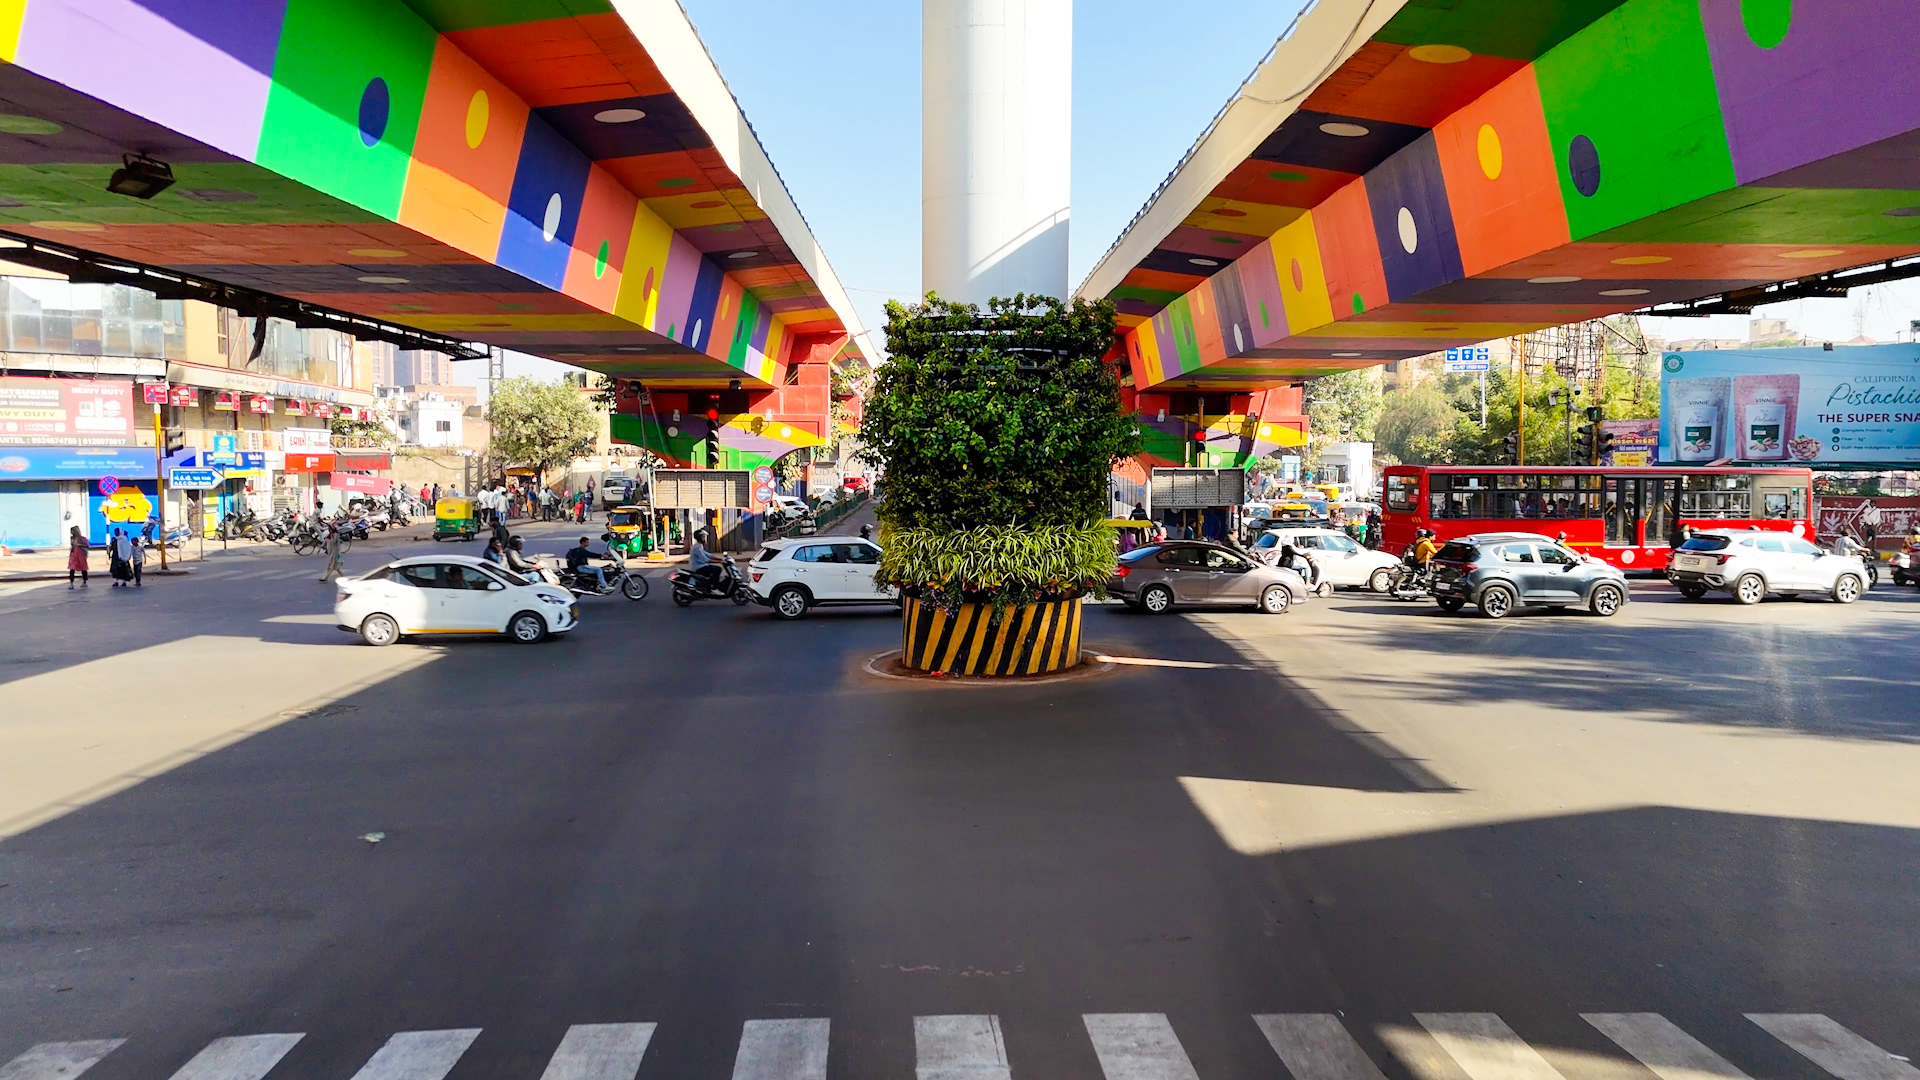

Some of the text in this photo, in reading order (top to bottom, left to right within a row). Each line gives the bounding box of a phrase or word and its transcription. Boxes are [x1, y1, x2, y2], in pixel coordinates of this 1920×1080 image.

[1854, 375, 1916, 383] CALIFORNIA
[71, 387, 124, 396] HEAVY DUTY
[1817, 413, 1843, 423] THE
[1847, 413, 1890, 423] SUPER
